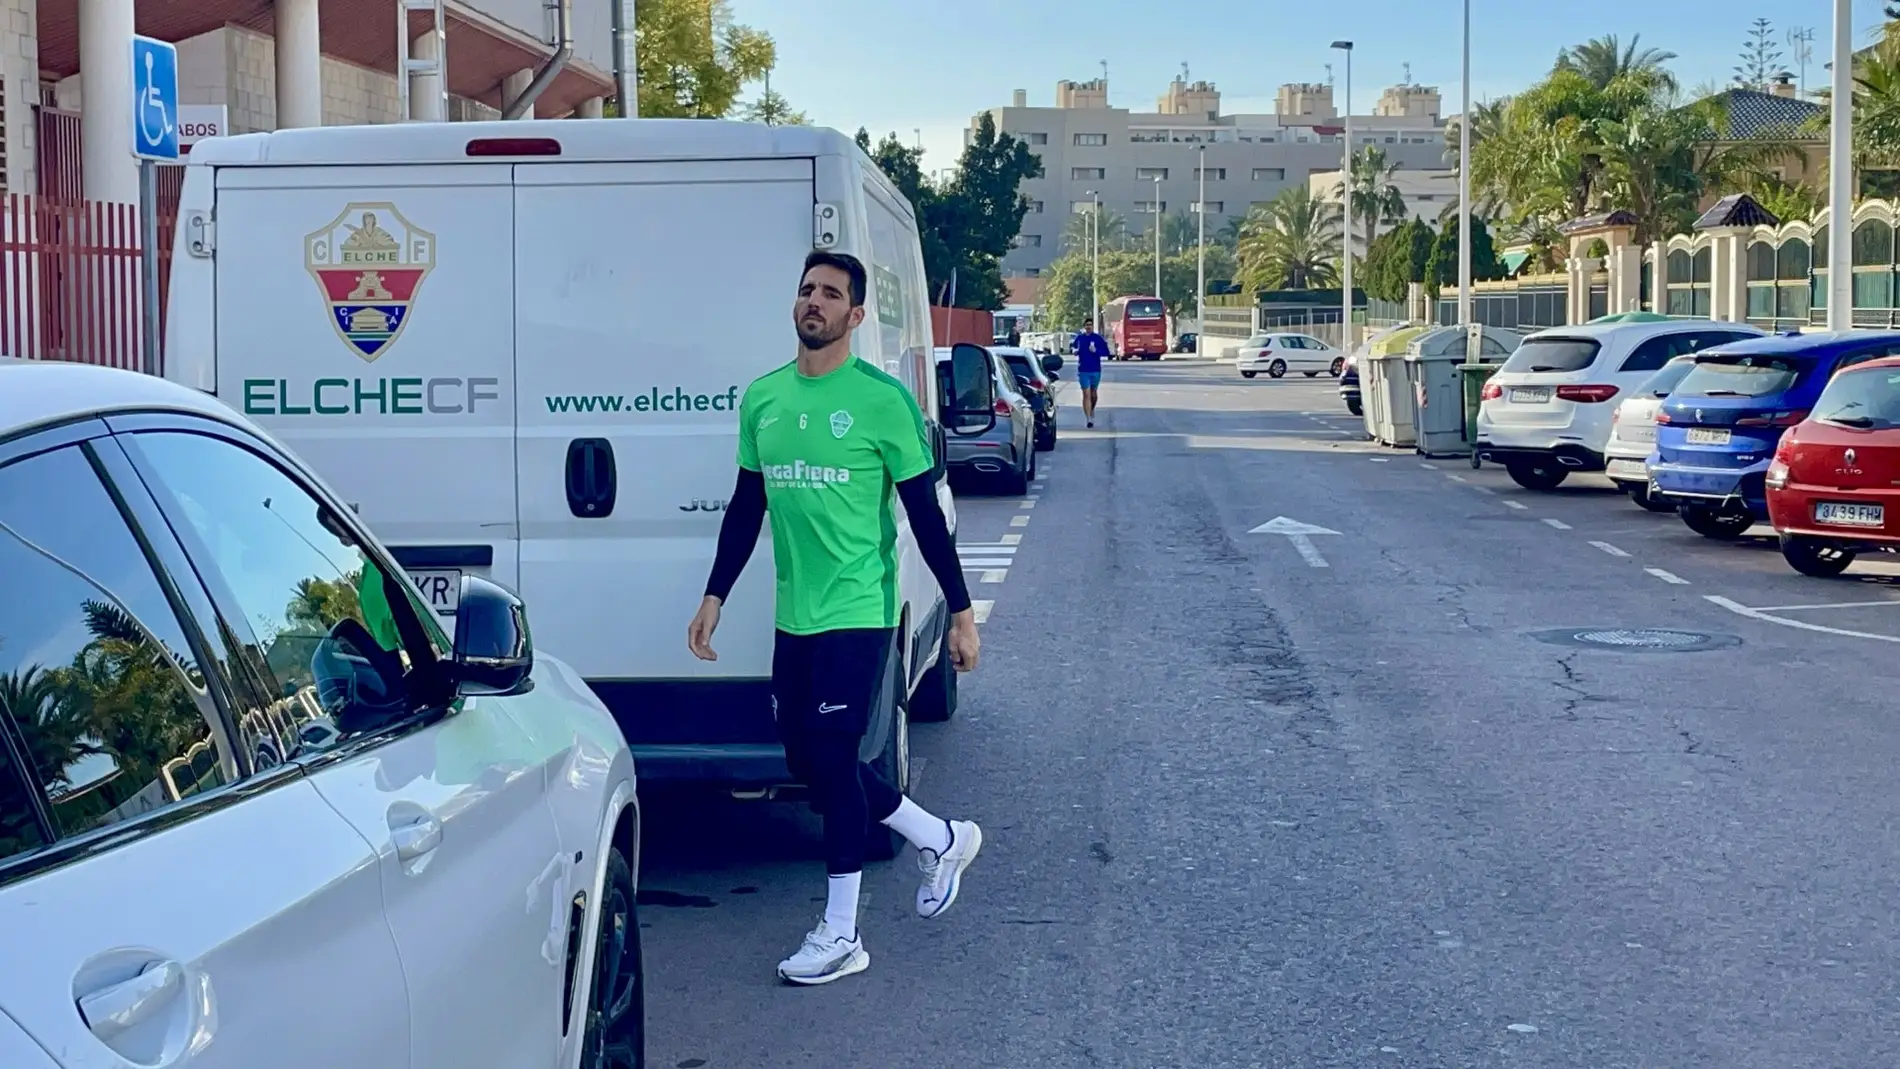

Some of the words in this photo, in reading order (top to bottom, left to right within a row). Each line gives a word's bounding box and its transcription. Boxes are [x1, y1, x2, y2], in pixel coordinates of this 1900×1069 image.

[343, 251, 397, 262] ELCHE
[545, 386, 738, 413] www.elchecf
[799, 413, 808, 429] 6
[410, 577, 450, 604] KR
